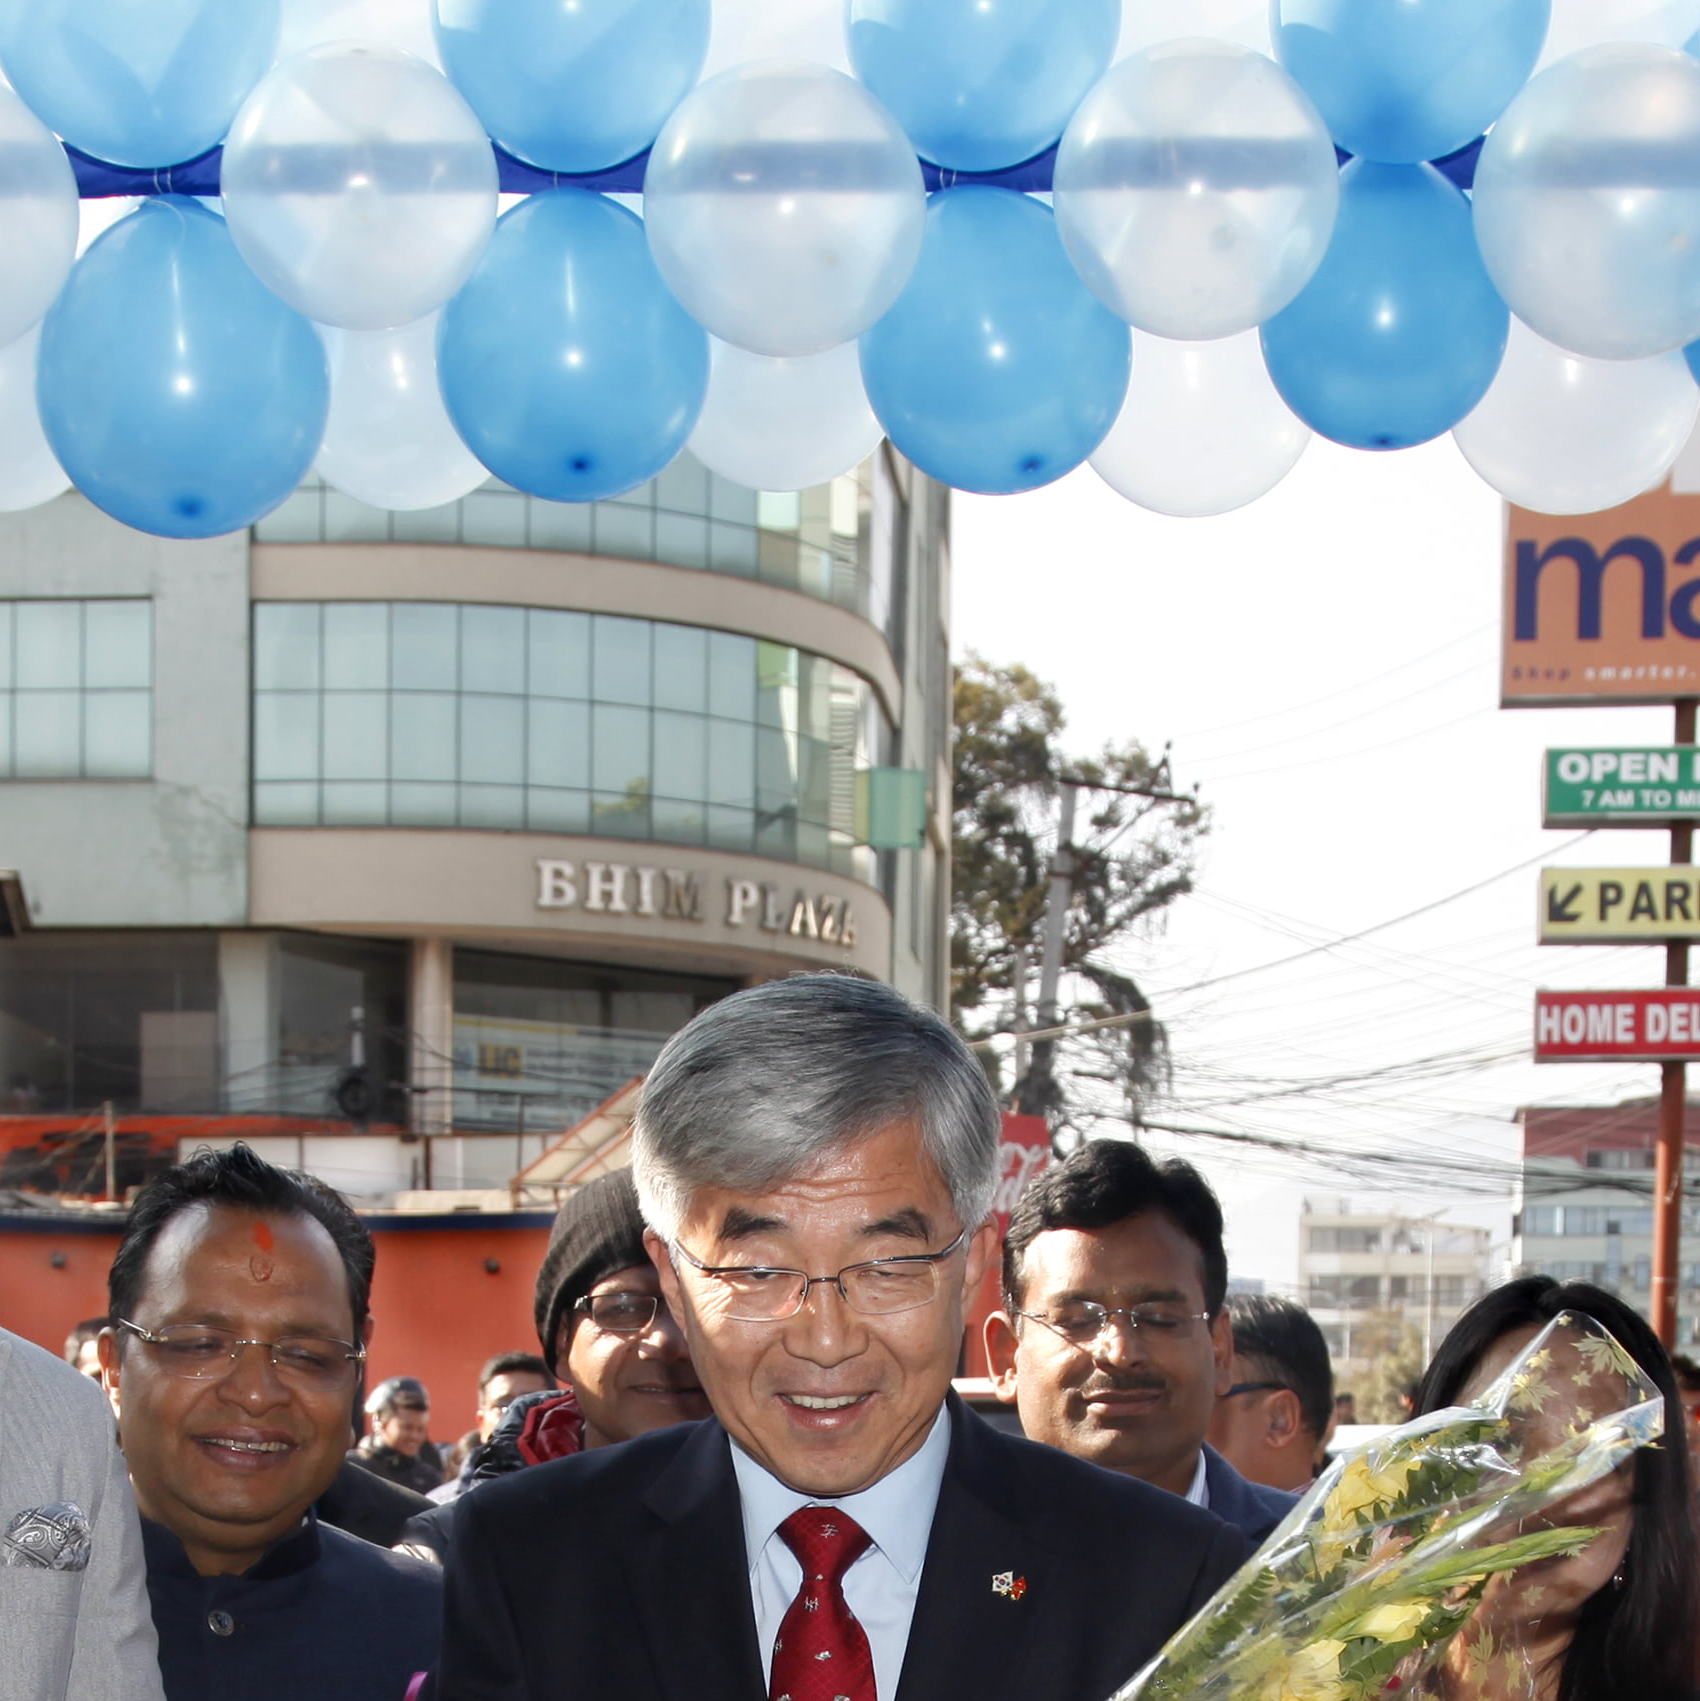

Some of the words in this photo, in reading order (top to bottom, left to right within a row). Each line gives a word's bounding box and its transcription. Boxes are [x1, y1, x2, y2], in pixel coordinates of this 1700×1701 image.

[1512, 666, 1571, 682] Shop
[1584, 664, 1696, 682] smarter.
[1557, 753, 1679, 783] OPEN
[1582, 790, 1596, 807] 7
[1599, 790, 1636, 807] AM
[1640, 790, 1673, 807] TO
[536, 858, 701, 921] BHIM
[1538, 1003, 1636, 1043] HOME
